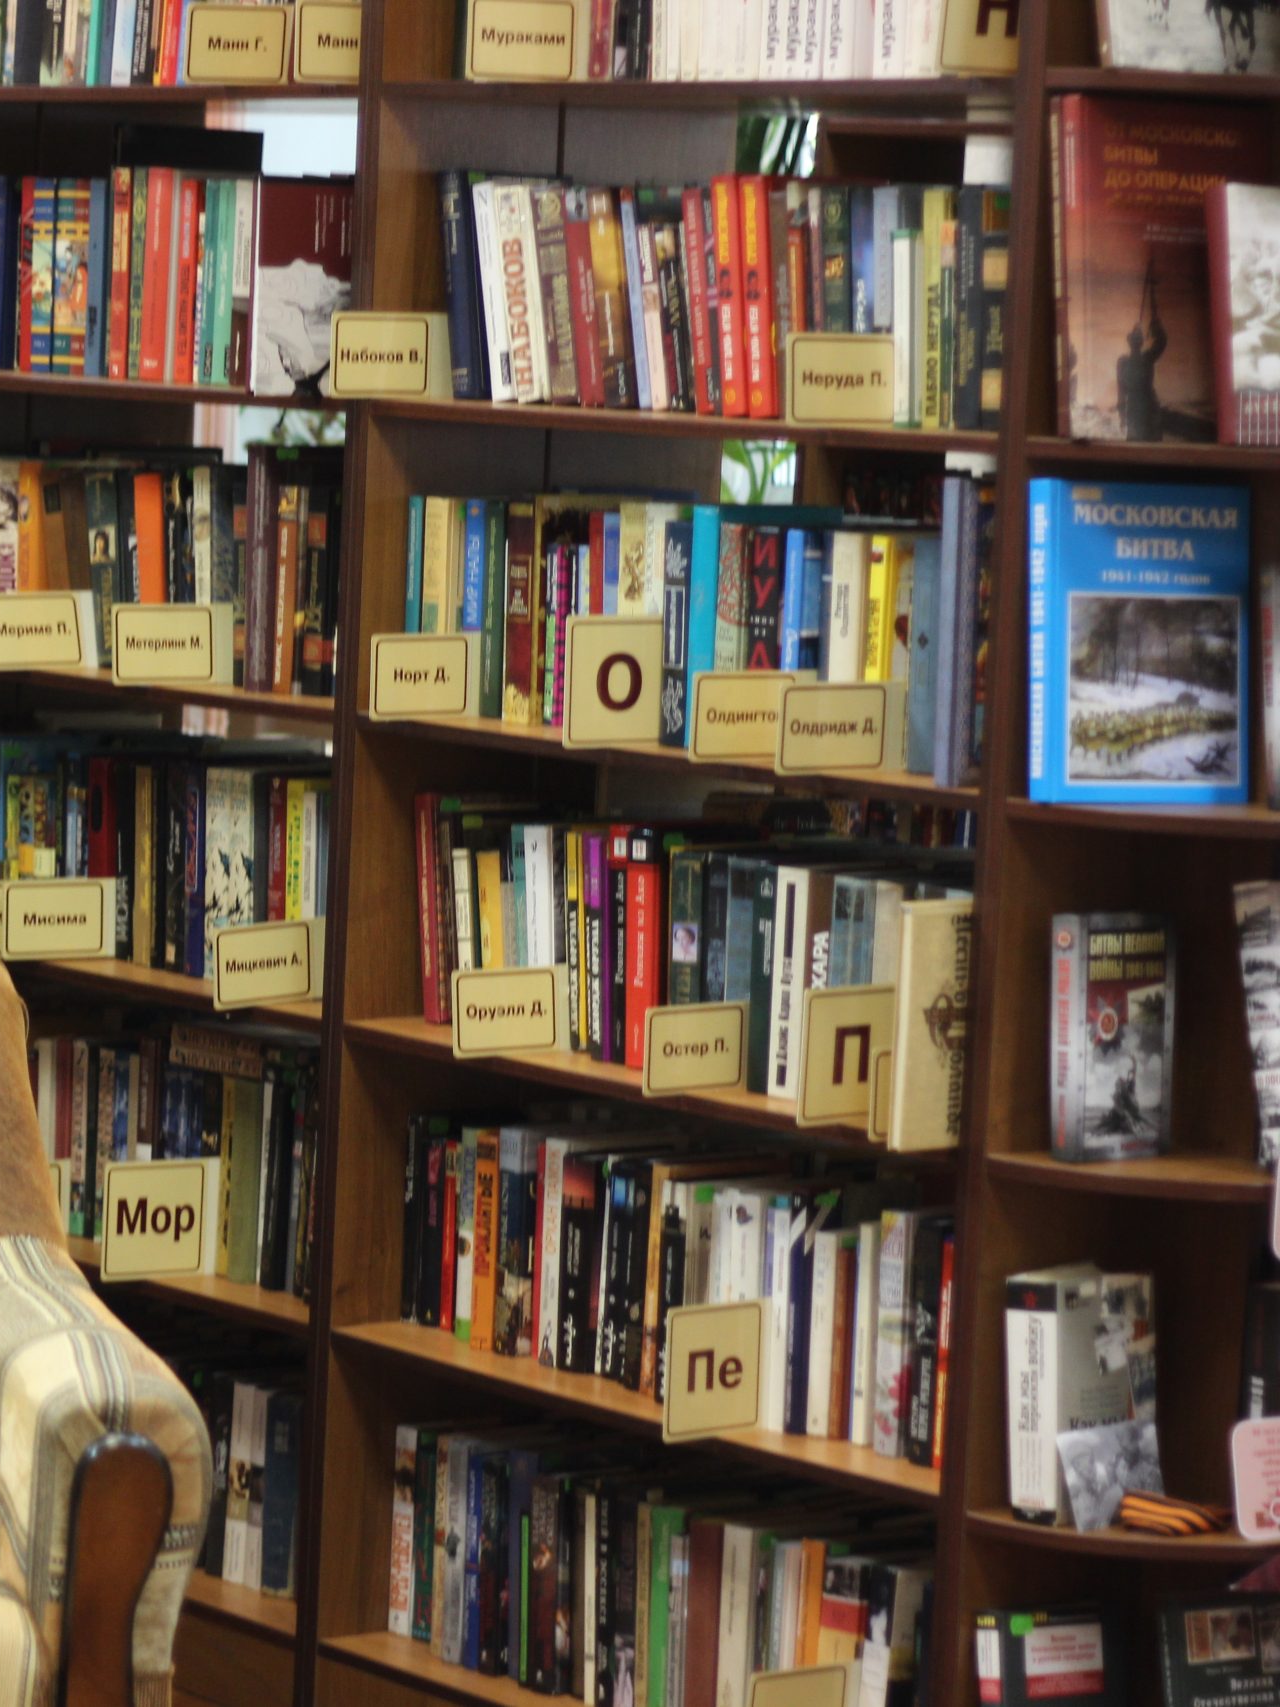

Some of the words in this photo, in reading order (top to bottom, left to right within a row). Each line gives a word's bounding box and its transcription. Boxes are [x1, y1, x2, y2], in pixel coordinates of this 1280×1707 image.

[207, 35, 249, 52] Манн
[254, 35, 267, 52] Г.
[317, 33, 358, 50] Манн
[480, 27, 566, 47] Мураками
[1104, 169, 1131, 190] ДО
[502, 237, 533, 387] НАБОКОВ
[340, 347, 403, 364] Набоков
[408, 347, 423, 365] В.
[801, 370, 864, 390] Неруда
[870, 369, 886, 388] П.
[1073, 502, 1239, 529] МОСКОВСКАЯ
[1115, 536, 1195, 561] БИТВА
[57, 620, 71, 635] П.
[125, 635, 187, 653] Метерлинк
[190, 635, 203, 650] М.
[393, 667, 429, 685] Норт
[433, 666, 450, 685] Д.
[596, 652, 643, 710] О
[706, 707, 779, 725] Олдингто
[790, 717, 857, 736] Олдридж
[862, 716, 878, 735] Д.
[23, 912, 87, 926] Мисима
[225, 955, 287, 974] Мицкевич
[290, 953, 302, 967] А.
[466, 1004, 525, 1022] Оруэлл
[530, 1000, 547, 1018] Д.
[662, 1041, 709, 1057] Остер
[714, 1036, 729, 1053] П.
[832, 1023, 872, 1085] П
[116, 1196, 196, 1242] Мор
[687, 1349, 743, 1394] Пе
